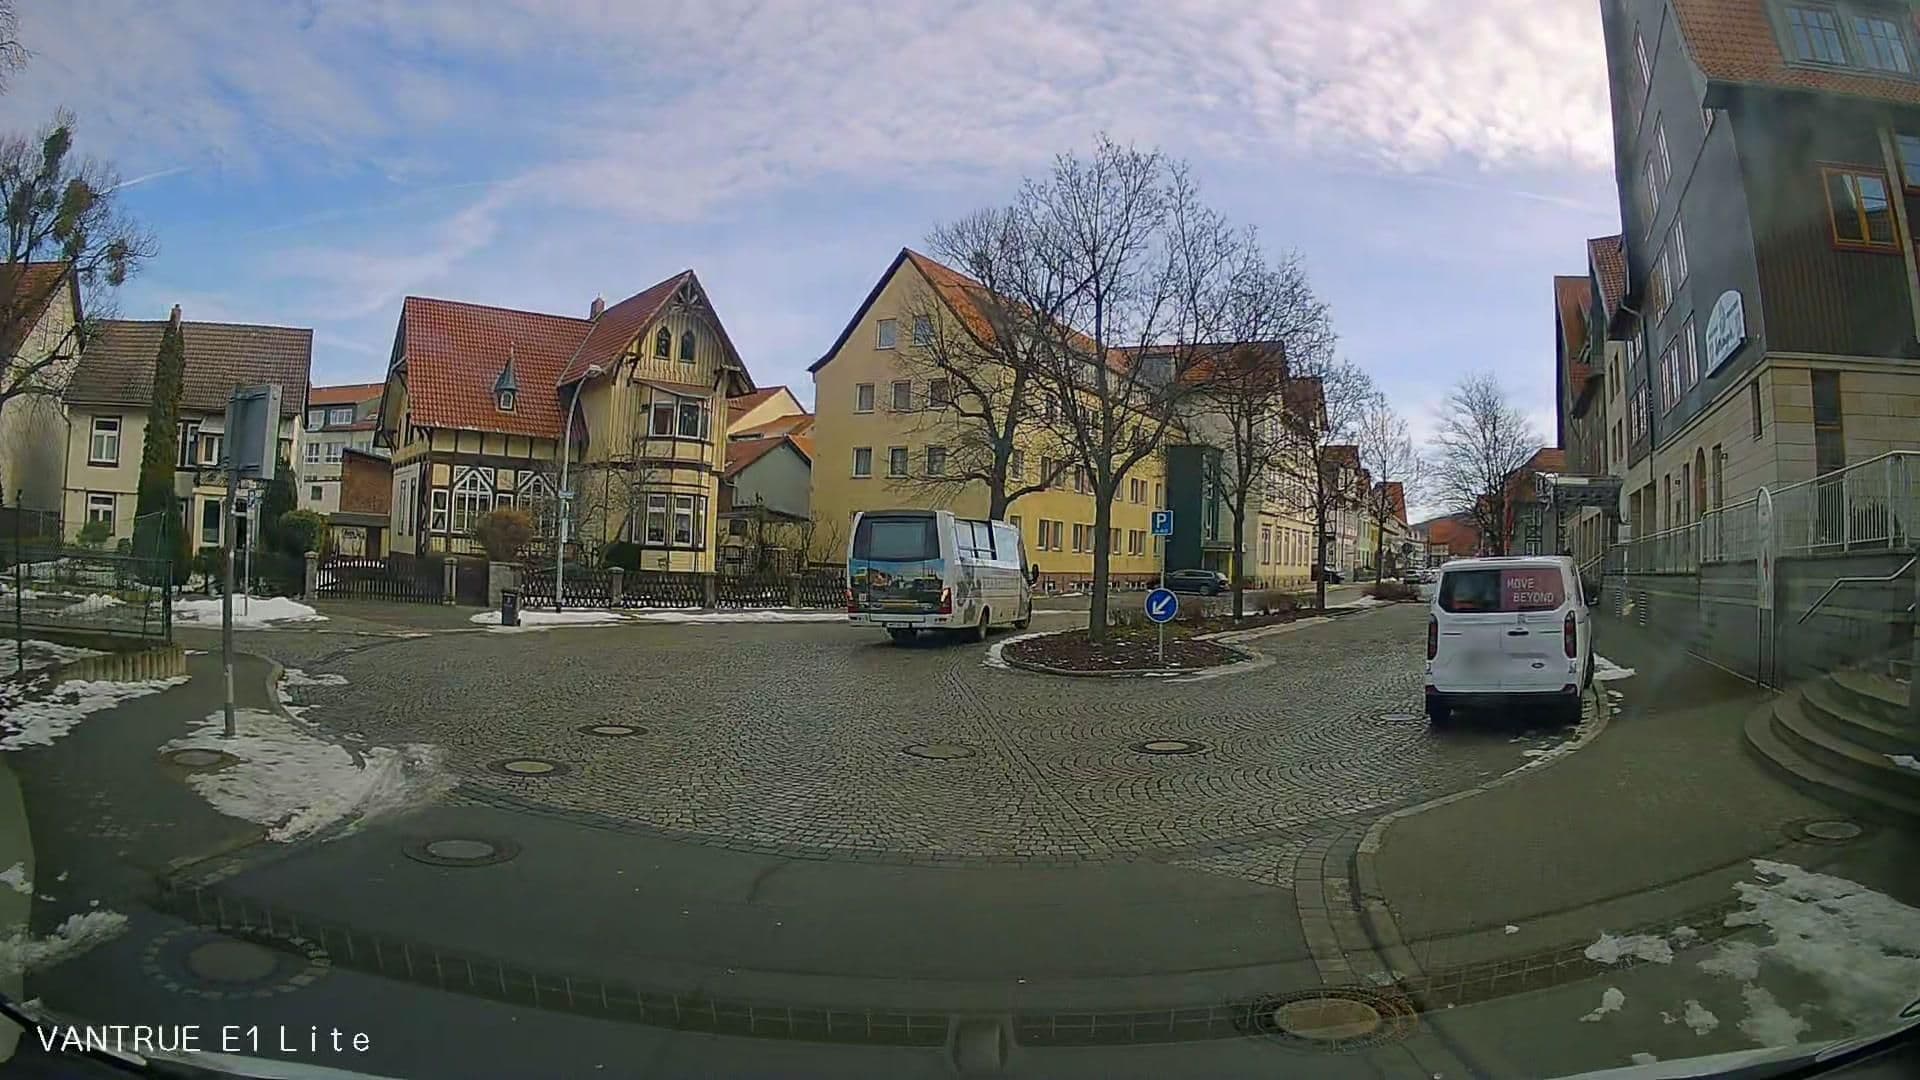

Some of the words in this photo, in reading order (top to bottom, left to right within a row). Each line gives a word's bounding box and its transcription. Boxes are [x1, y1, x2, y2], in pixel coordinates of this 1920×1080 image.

[1156, 513, 1167, 529] P
[1507, 577, 1535, 589] MOVE
[1513, 592, 1554, 603] BEYOND
